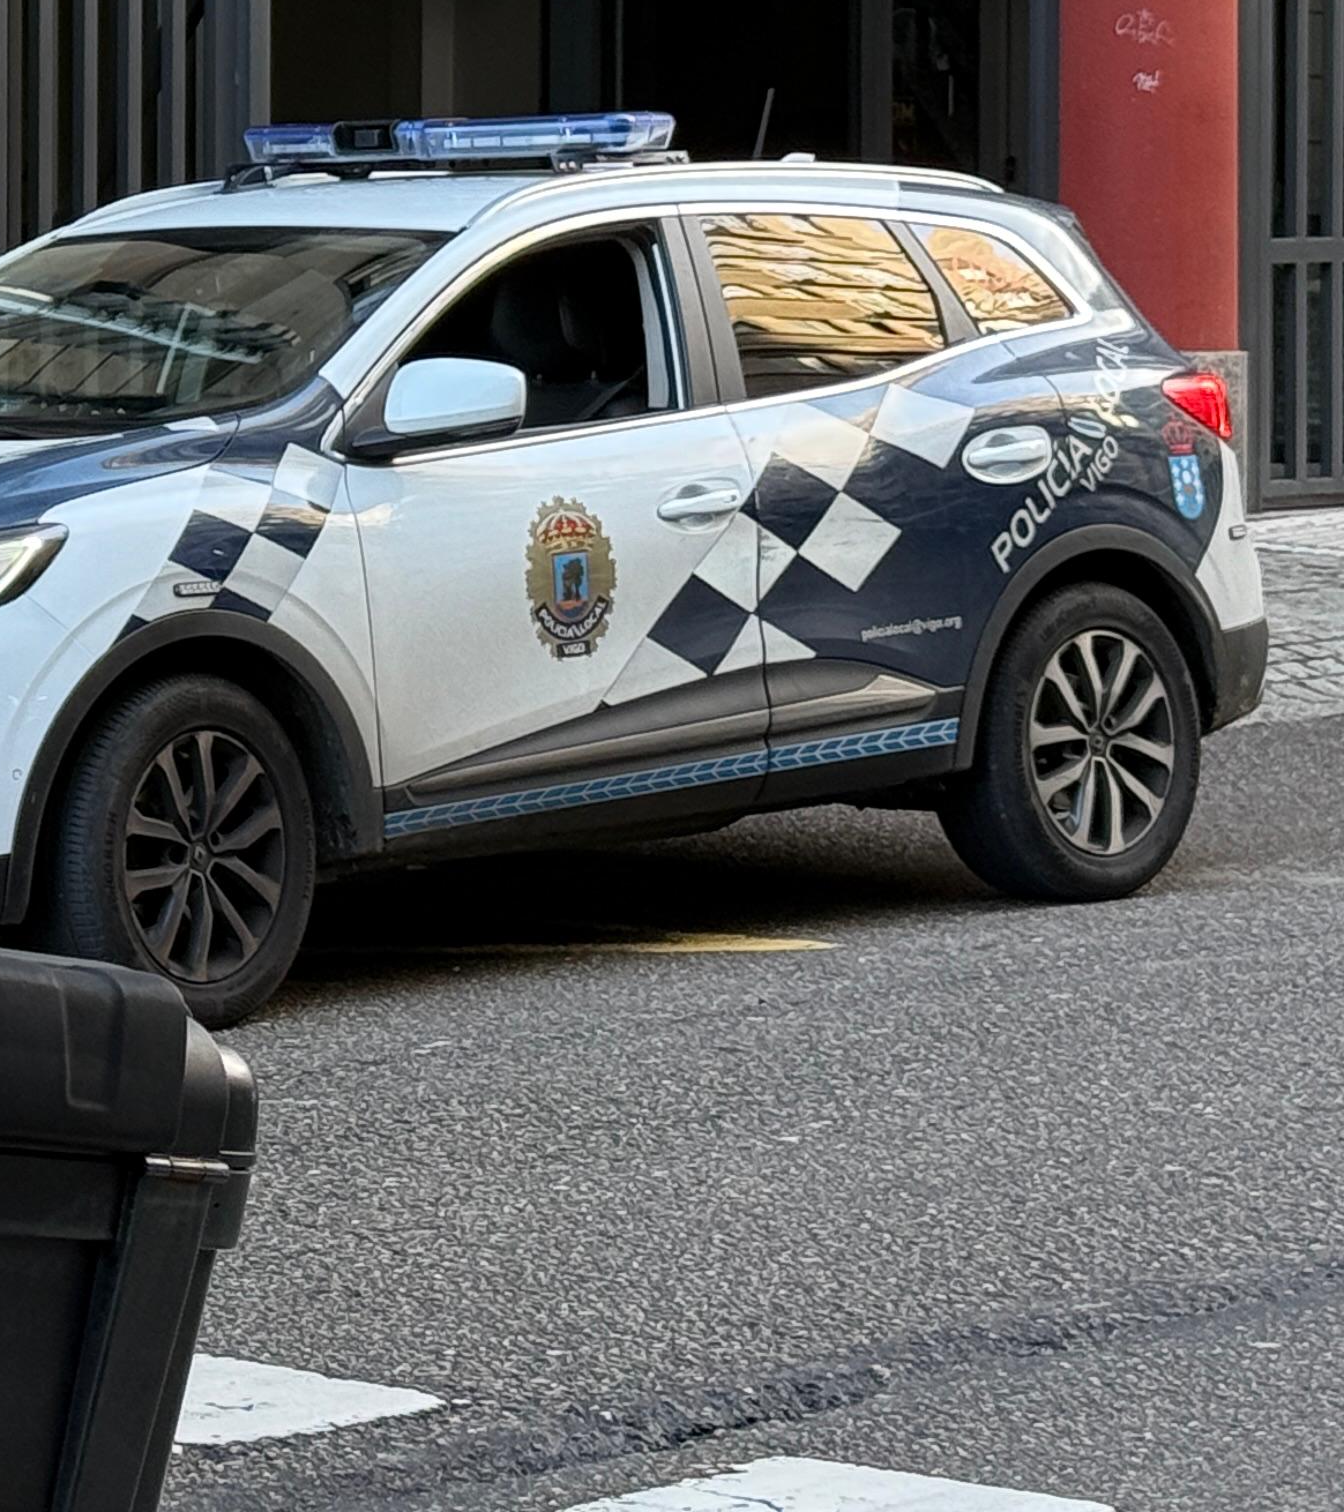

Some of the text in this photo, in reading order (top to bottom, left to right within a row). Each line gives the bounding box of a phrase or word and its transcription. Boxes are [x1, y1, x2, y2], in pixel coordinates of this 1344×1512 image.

[1079, 435, 1120, 493] VIGO
[989, 433, 1094, 574] POLICÍA
[578, 602, 607, 636] LOCAL
[562, 642, 585, 654] VIGO
